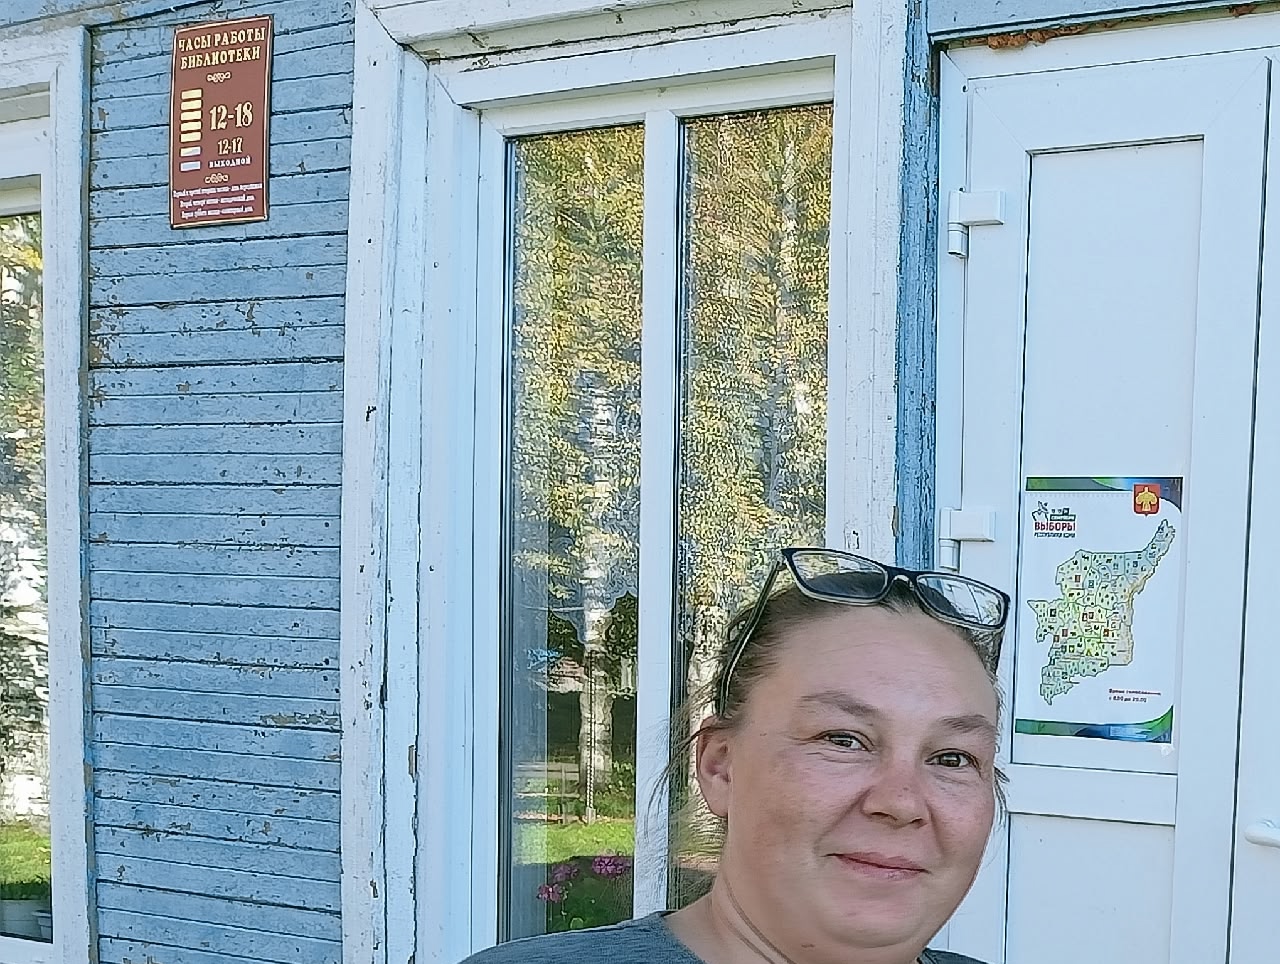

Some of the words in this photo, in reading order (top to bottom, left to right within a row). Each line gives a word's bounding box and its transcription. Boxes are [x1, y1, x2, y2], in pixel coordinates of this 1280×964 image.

[178, 34, 212, 52] ЧАСЫ
[214, 27, 266, 47] РАБОТЫ
[180, 46, 261, 70] БИБЛИОТЕКИ
[209, 101, 253, 131] 12-18
[217, 137, 243, 156] 12-17
[1034, 521, 1076, 532] ВЫБОРЫ
